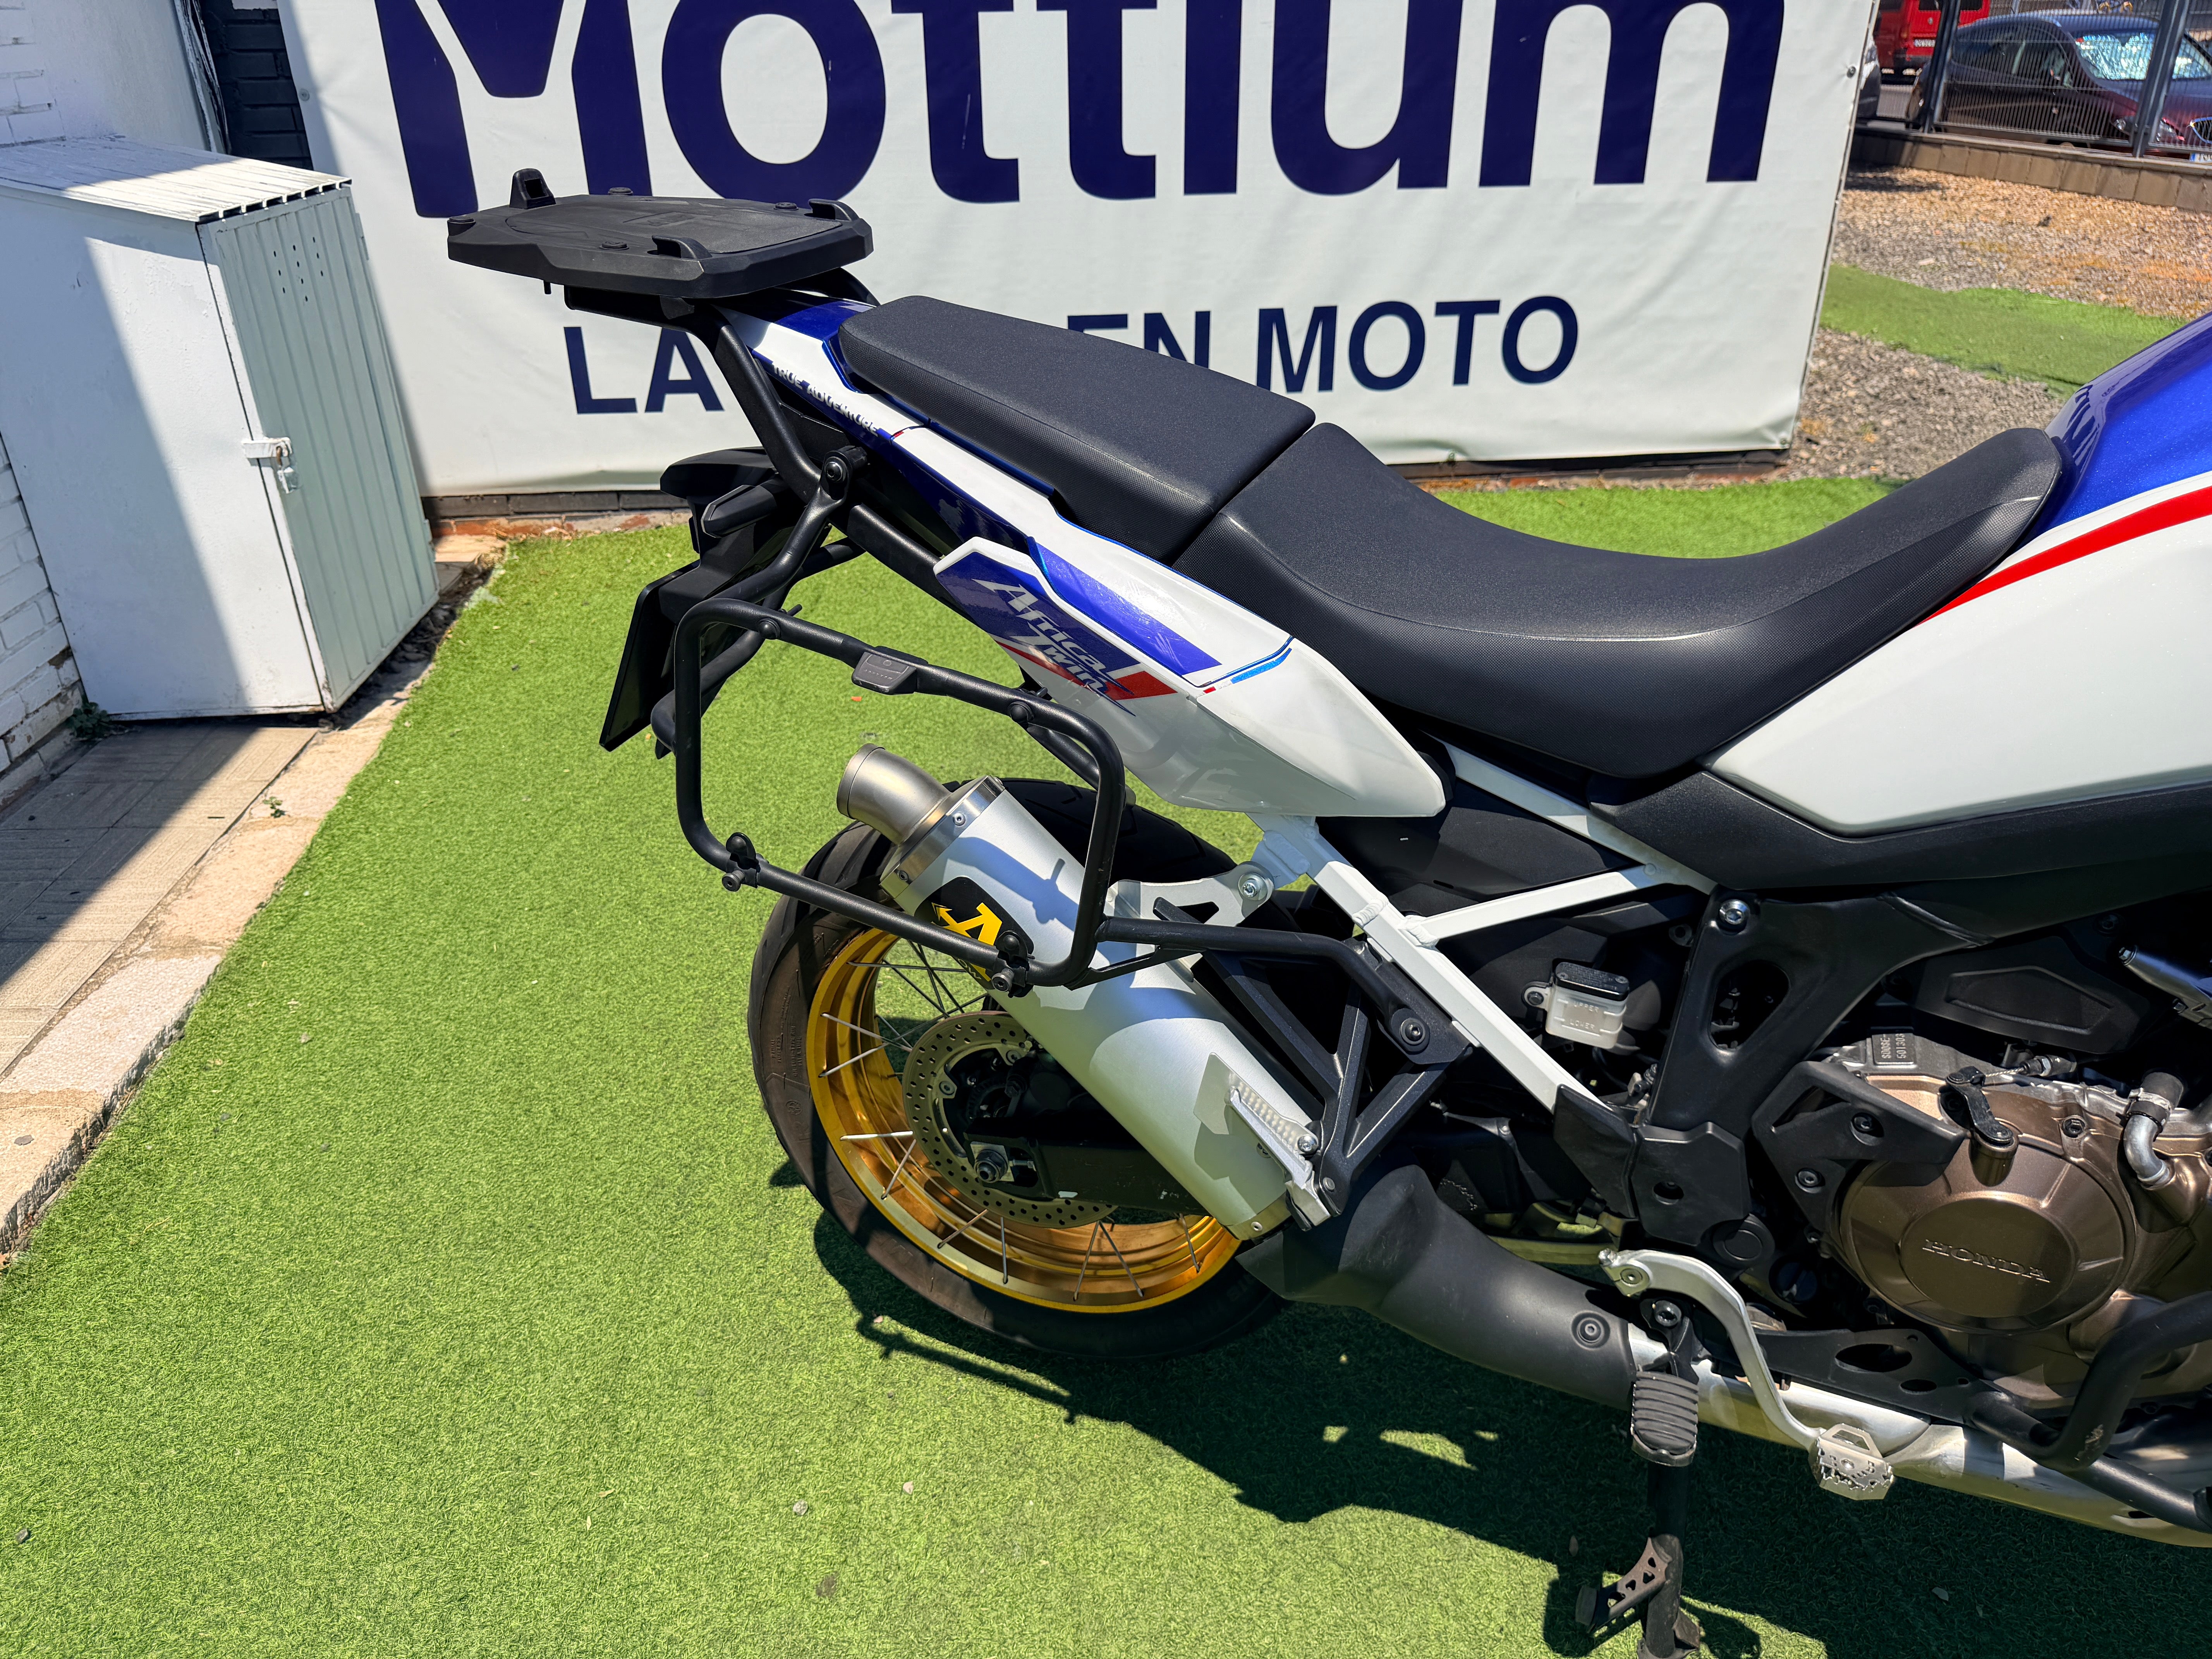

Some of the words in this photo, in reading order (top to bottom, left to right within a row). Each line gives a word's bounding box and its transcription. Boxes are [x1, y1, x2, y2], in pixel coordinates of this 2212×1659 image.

[564, 326, 725, 414] LA
[1256, 295, 1579, 394] MOTO
[772, 363, 803, 390] TRUE
[807, 384, 879, 437] ADVENTURE
[971, 579, 1125, 687] Africa
[1009, 622, 1126, 707] Twin
[1570, 1018, 1595, 1031] LOWER
[1573, 1001, 1599, 1013] UPPER
[1922, 1239, 2051, 1283] HONDA
